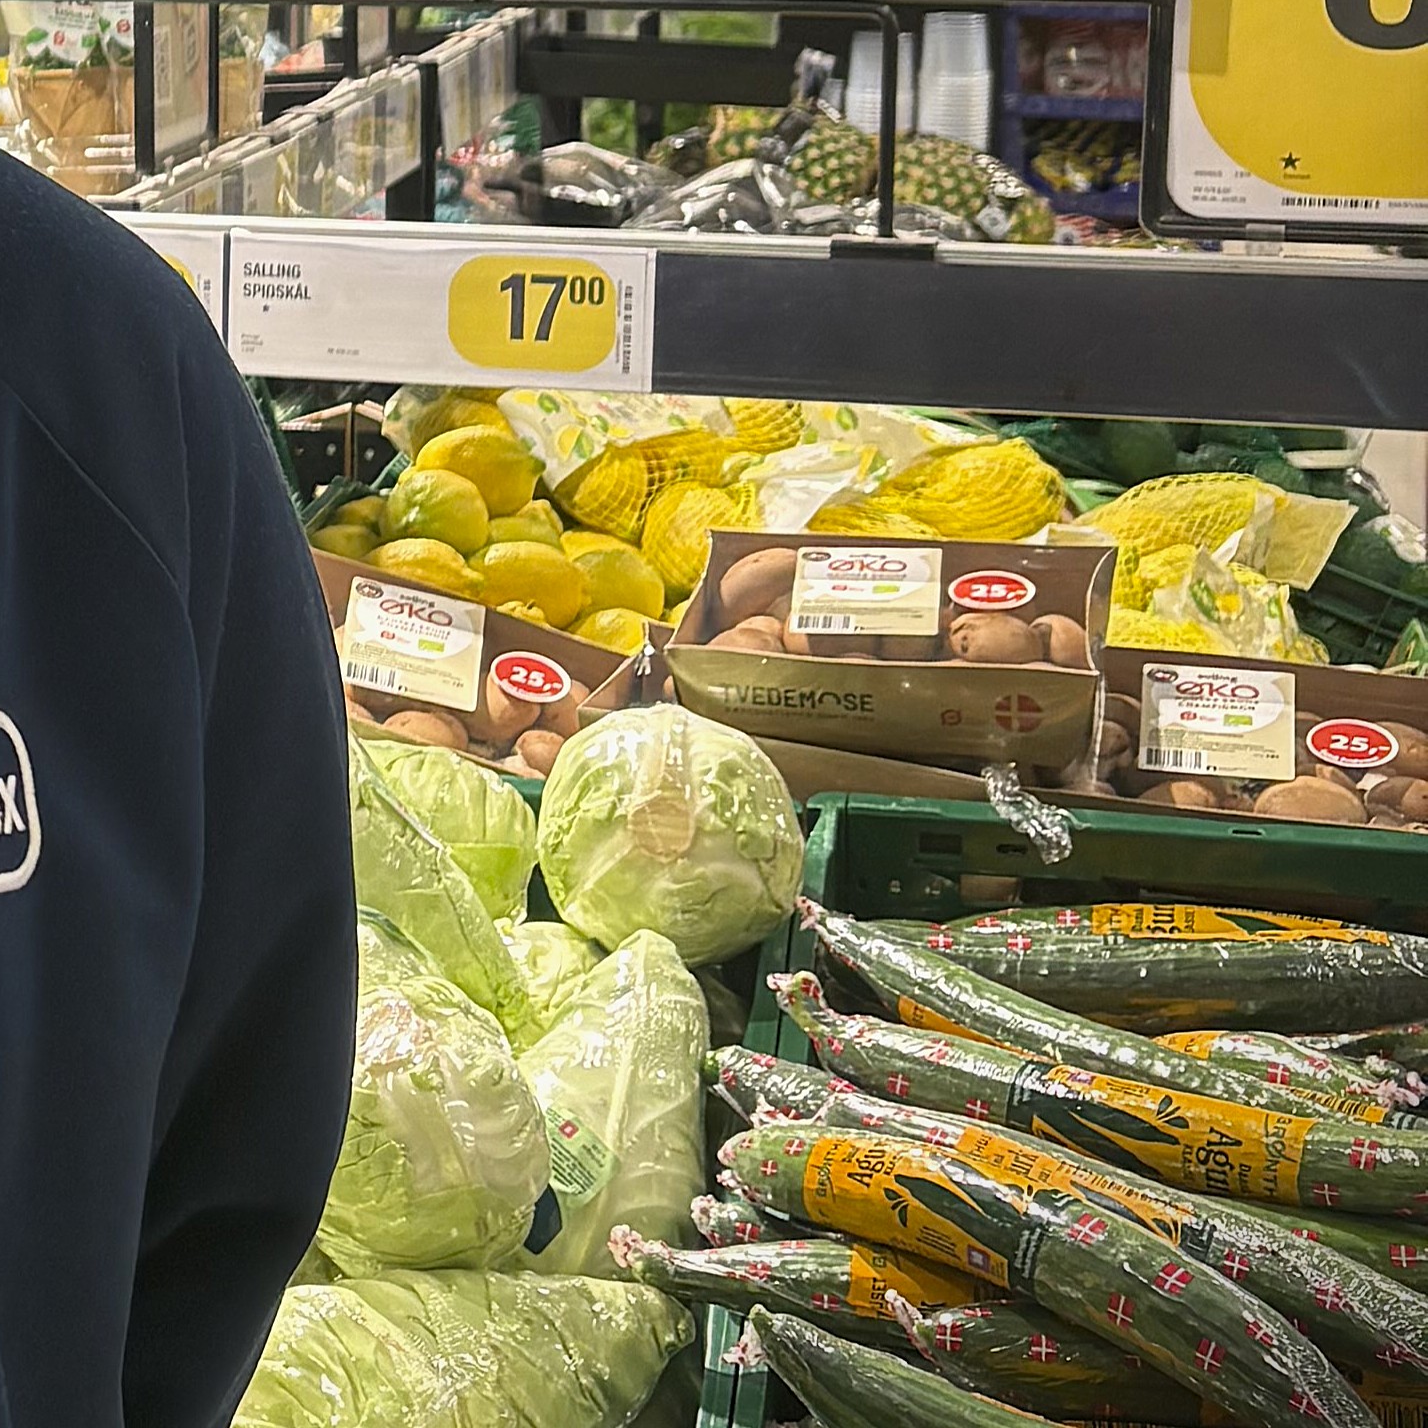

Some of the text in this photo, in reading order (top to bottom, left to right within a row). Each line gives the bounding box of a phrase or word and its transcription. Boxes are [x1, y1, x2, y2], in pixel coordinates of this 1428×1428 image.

[243, 262, 301, 279] SALLING
[243, 280, 312, 301] SPIDSKÅL
[500, 272, 606, 343] 17 00
[379, 598, 454, 627] ØKO
[723, 681, 875, 712] TVEDEMOSE
[1176, 681, 1260, 700] ØKO
